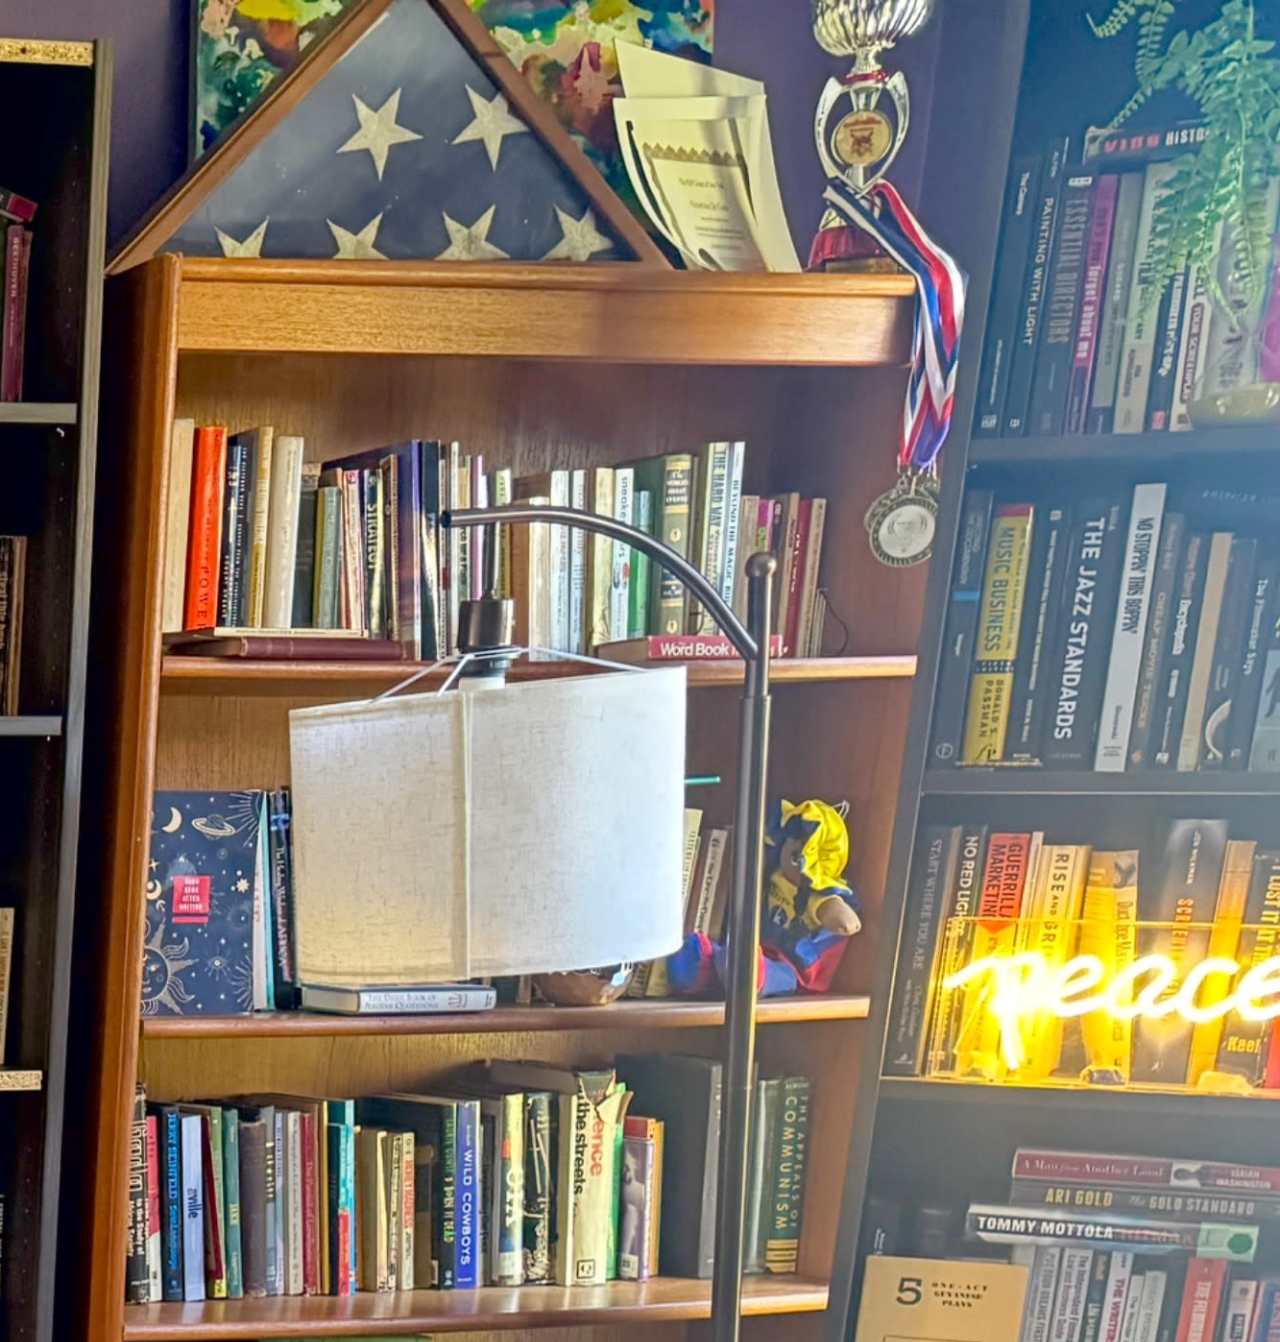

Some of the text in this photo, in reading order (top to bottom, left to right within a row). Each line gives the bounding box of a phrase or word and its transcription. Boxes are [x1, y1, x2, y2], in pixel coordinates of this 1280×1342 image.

[1022, 197, 1054, 346] PAINTING WITH LIGHT
[710, 450, 726, 527] THE HARD WAY
[984, 526, 1016, 652] MUSIC BUSINESS
[1053, 517, 1105, 740] THE JAZZ STANDARDS
[661, 643, 728, 656] Word Book
[979, 679, 995, 739] PASSMAN
[942, 952, 1280, 1070] peace
[459, 1149, 474, 1265] WILD COWBOYS
[775, 1096, 798, 1230] COMMUNISM
[976, 1215, 1113, 1240] TOMMY MOTTOLA
[895, 1276, 923, 1306] 5
